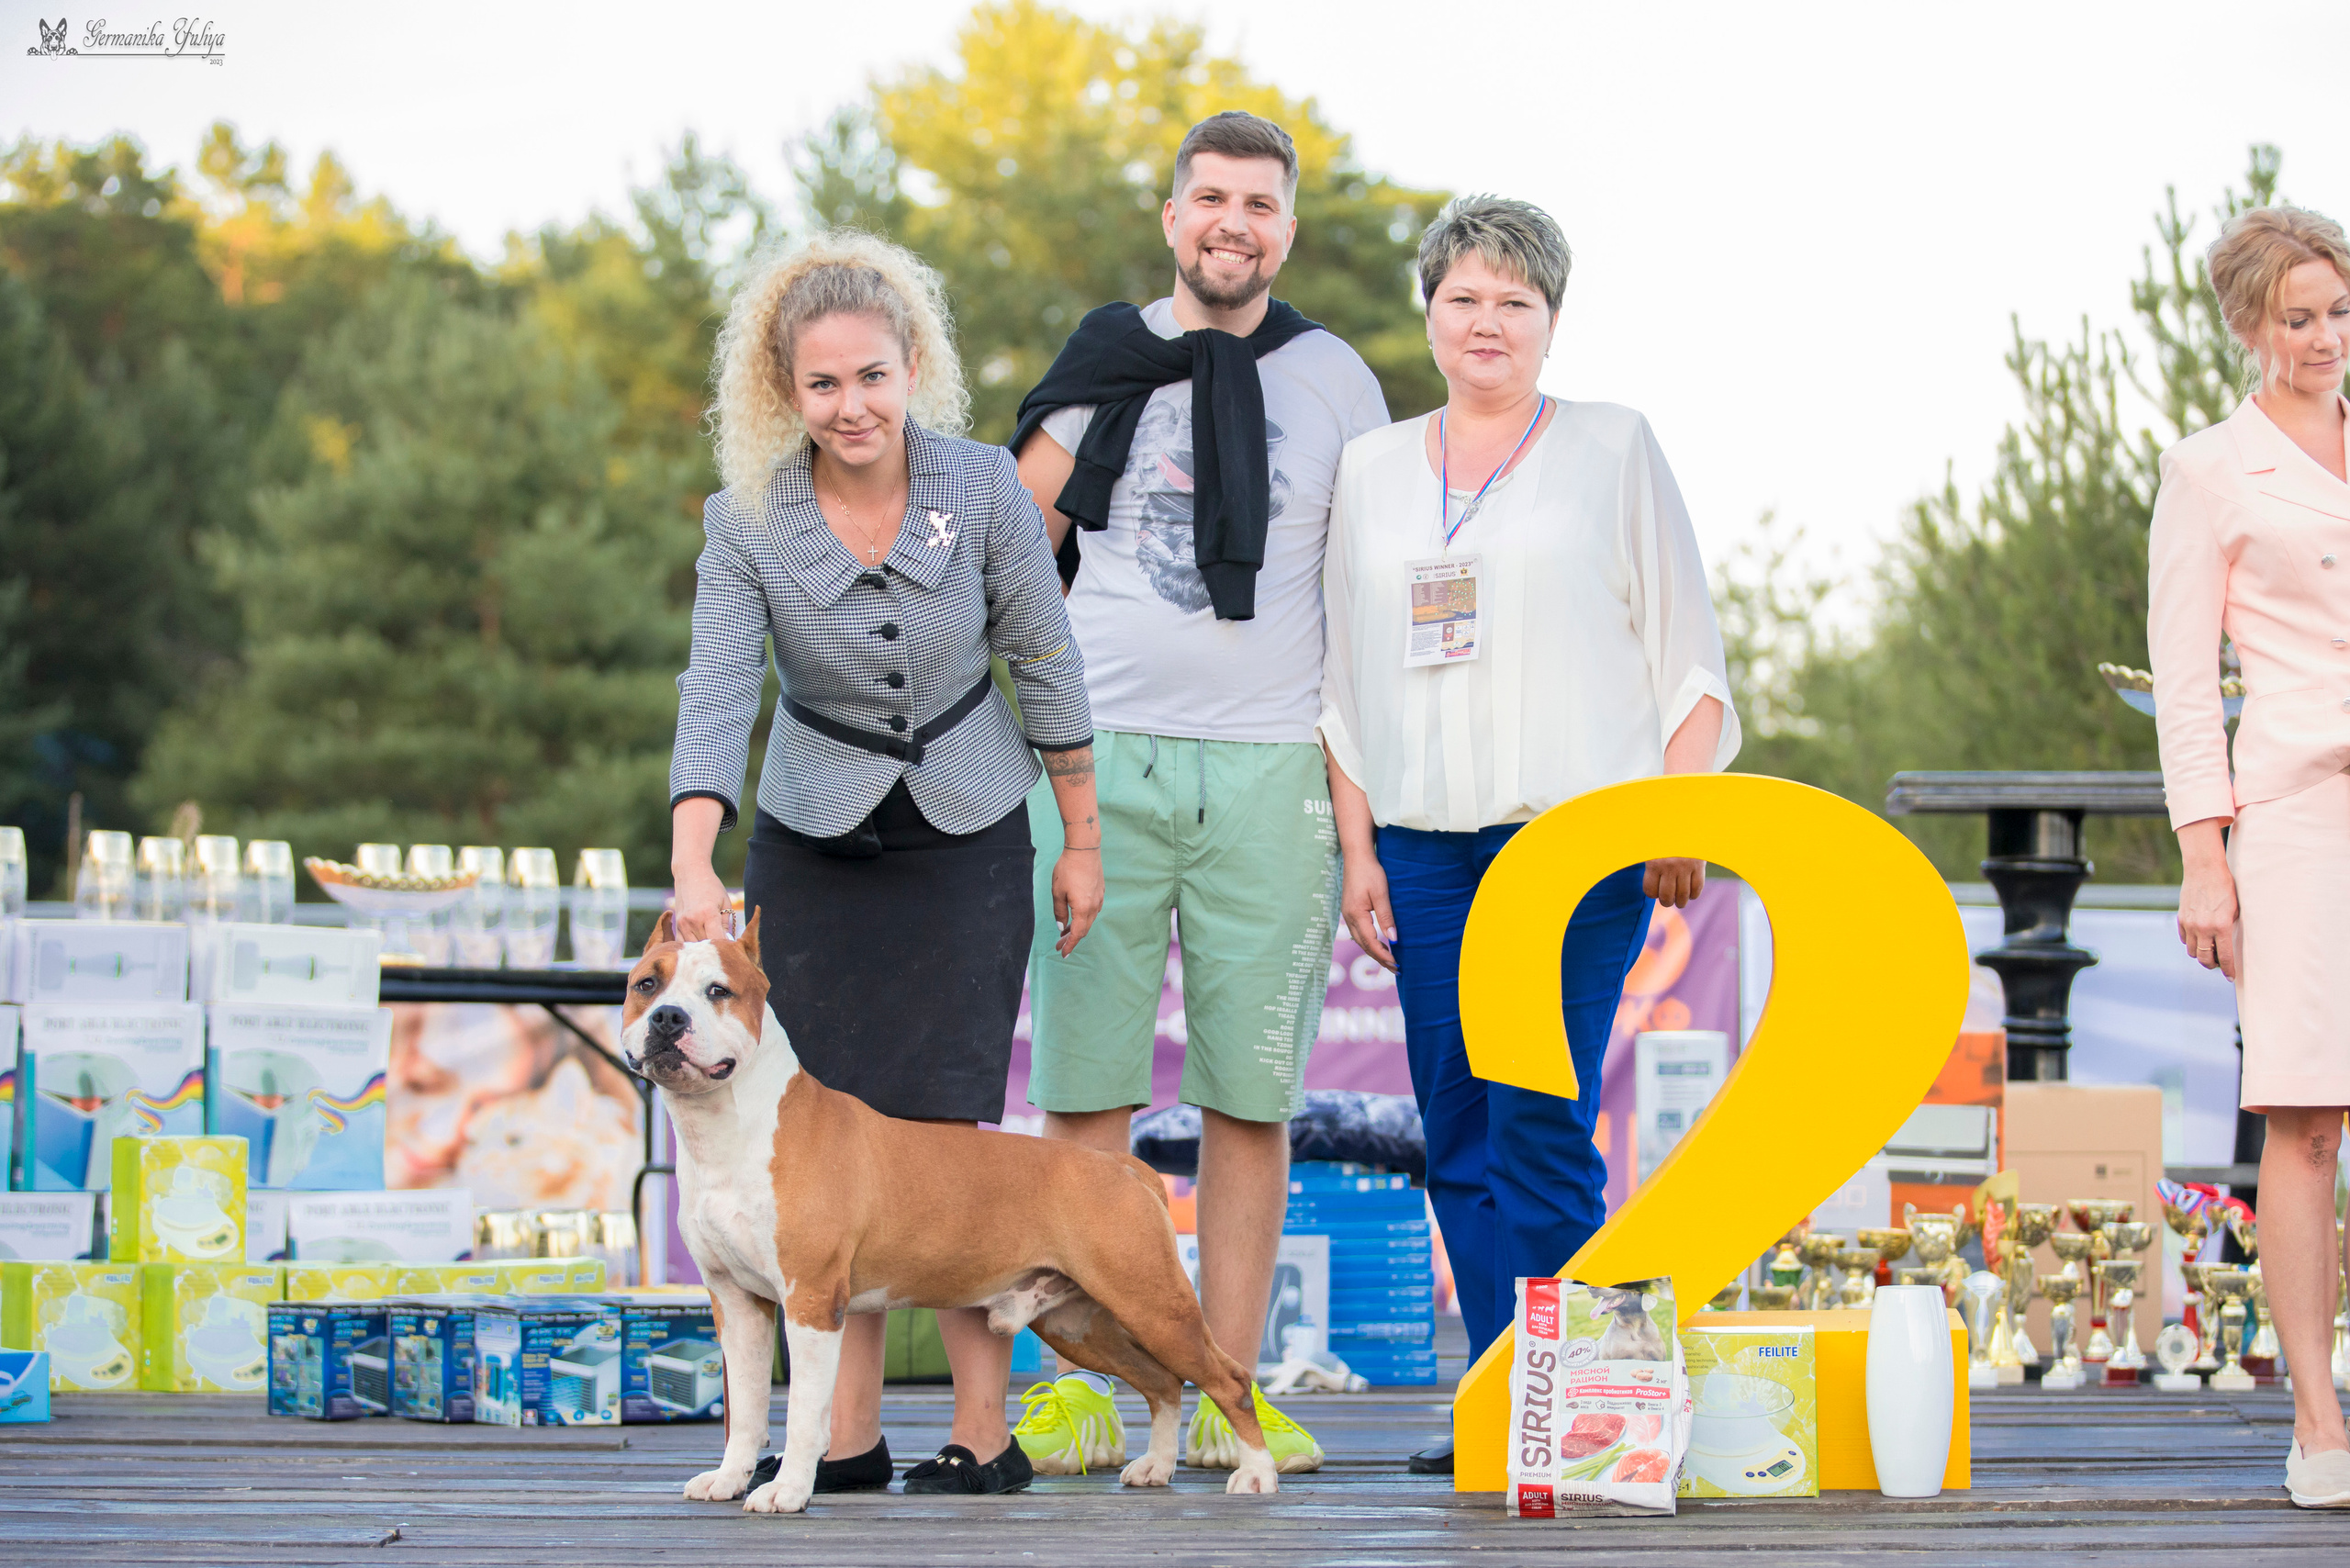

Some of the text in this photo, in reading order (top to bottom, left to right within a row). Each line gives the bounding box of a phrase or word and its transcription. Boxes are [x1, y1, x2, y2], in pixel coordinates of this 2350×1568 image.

[1435, 571, 1456, 579] SIRIUS
[1455, 773, 1971, 1493] 2
[1530, 1313, 1554, 1325] ADULT
[1568, 1346, 1591, 1359] 40%
[1759, 1346, 1798, 1357] FEILITE
[1570, 1366, 1610, 1377] МЯСНОЙ
[1570, 1375, 1608, 1384] РАЦИОН
[1635, 1387, 1667, 1397] ProStor+
[1522, 1350, 1556, 1468] SIRIUS
[1522, 1491, 1548, 1500] ADULT
[1561, 1493, 1603, 1503] SIRIUS
